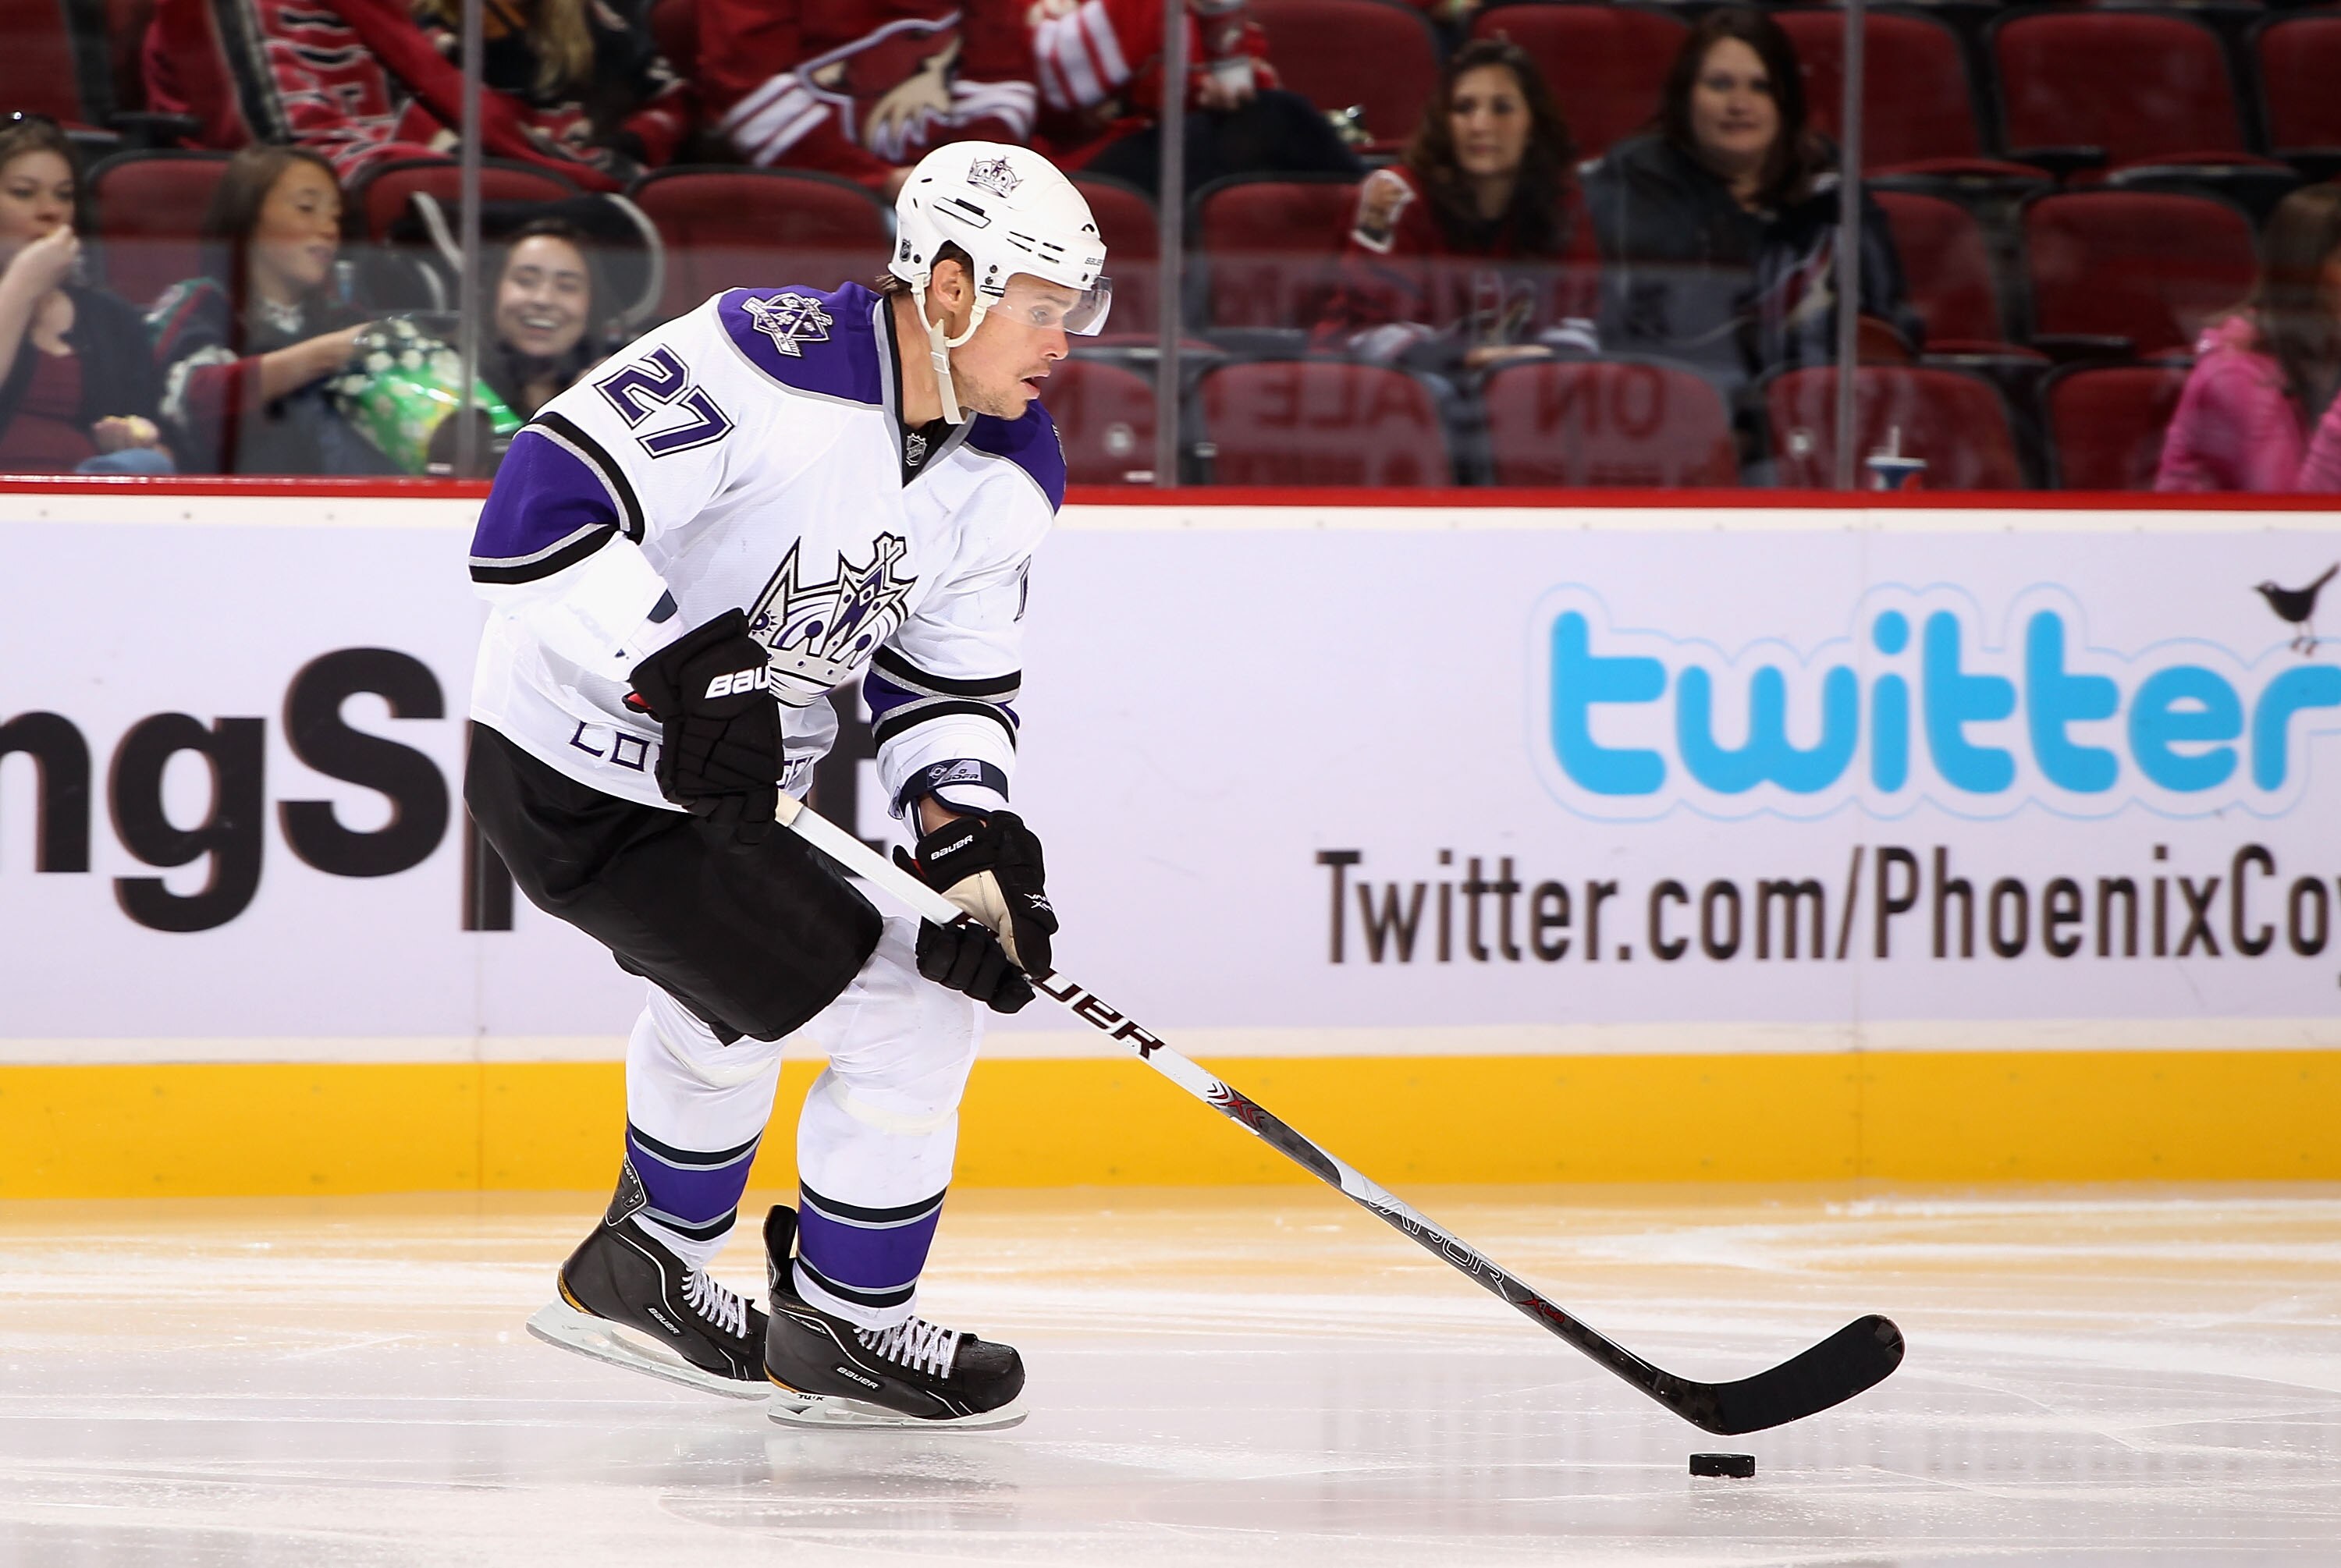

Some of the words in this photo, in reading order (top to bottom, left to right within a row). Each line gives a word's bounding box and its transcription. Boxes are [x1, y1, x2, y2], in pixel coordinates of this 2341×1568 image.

[591, 343, 735, 459] 27
[1550, 609, 2341, 796] twitter
[931, 834, 974, 860] BAUER
[1316, 843, 2341, 988] Twitter.com/PhoenixCo
[1361, 1172, 1510, 1301] VAPOR
[647, 1307, 680, 1335] BAUER
[836, 1366, 880, 1390] BAUER
